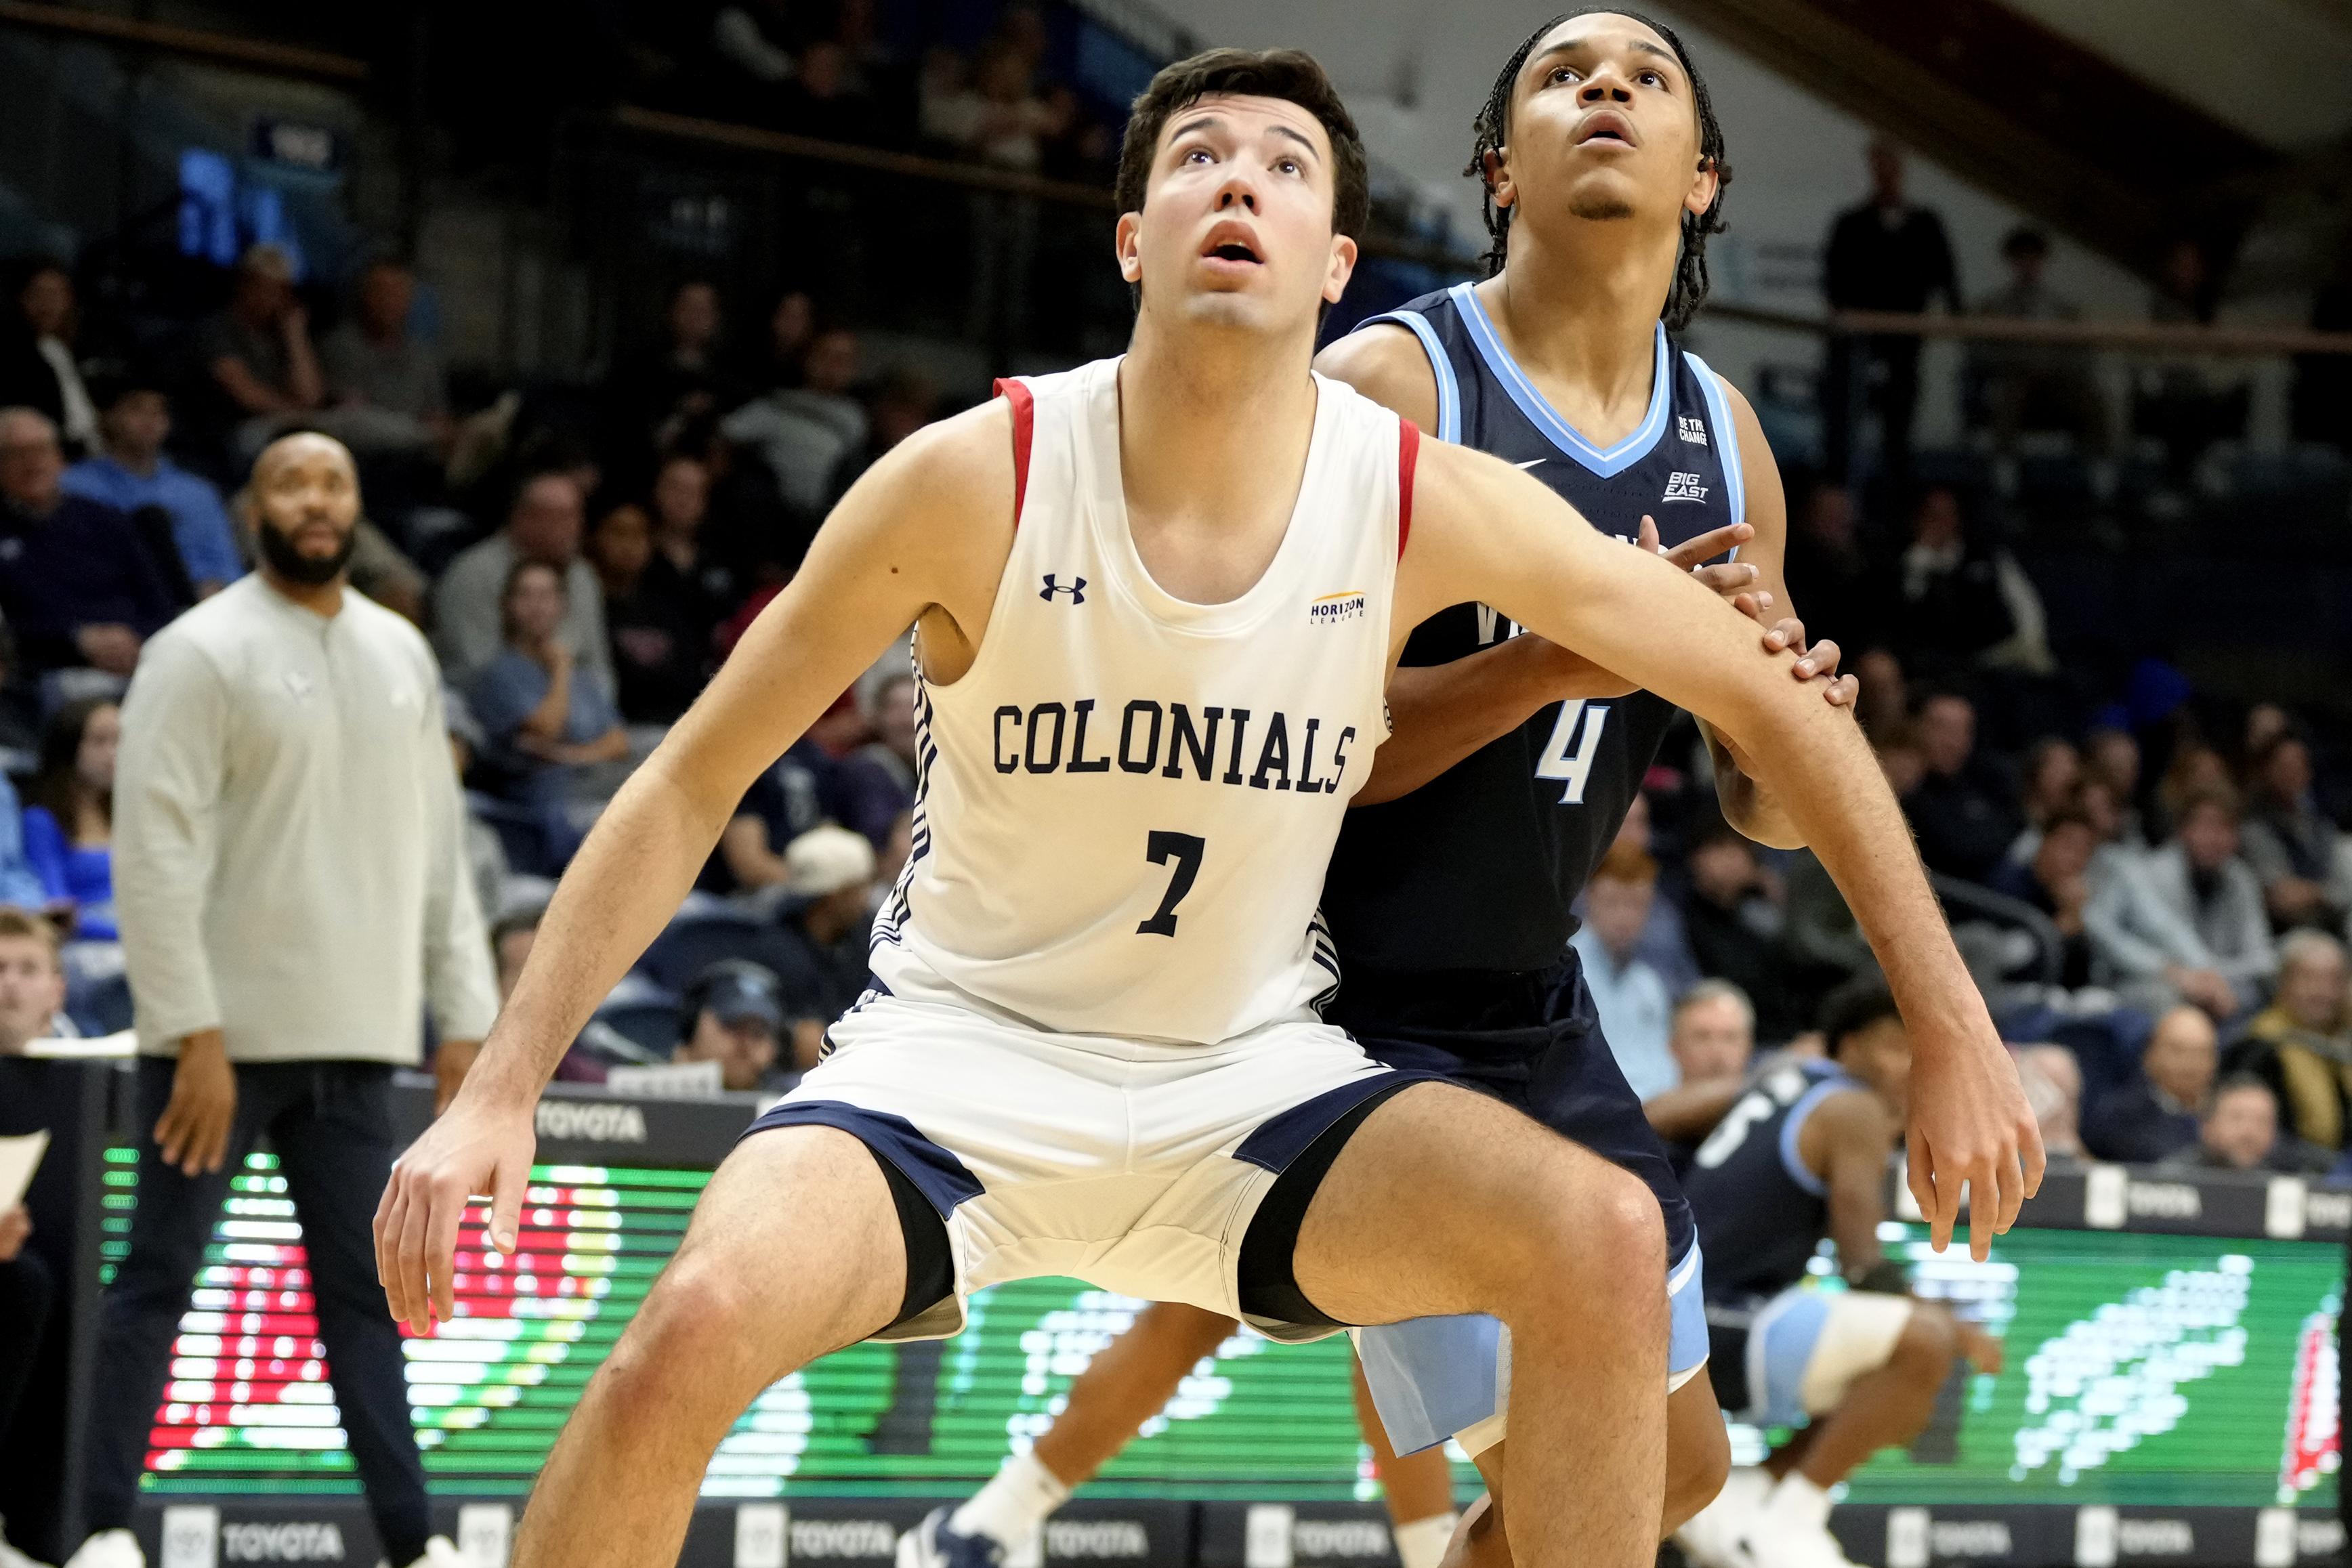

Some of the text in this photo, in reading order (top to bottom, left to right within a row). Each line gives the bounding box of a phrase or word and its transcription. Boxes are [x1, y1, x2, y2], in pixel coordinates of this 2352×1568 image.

[1679, 416, 1689, 430] BE
[1679, 429, 1708, 446] CHANGE
[1668, 471, 1700, 486] BIG
[1664, 484, 1708, 499] EAST
[1311, 597, 1364, 616] HORIZON
[1310, 610, 1364, 624] LEAGUE
[994, 699, 1356, 794] COLONIALS
[1534, 699, 1611, 804] 4
[1135, 830, 1206, 937] 7
[223, 1523, 345, 1561] TOYOTA
[791, 1521, 896, 1558] TOYOTA
